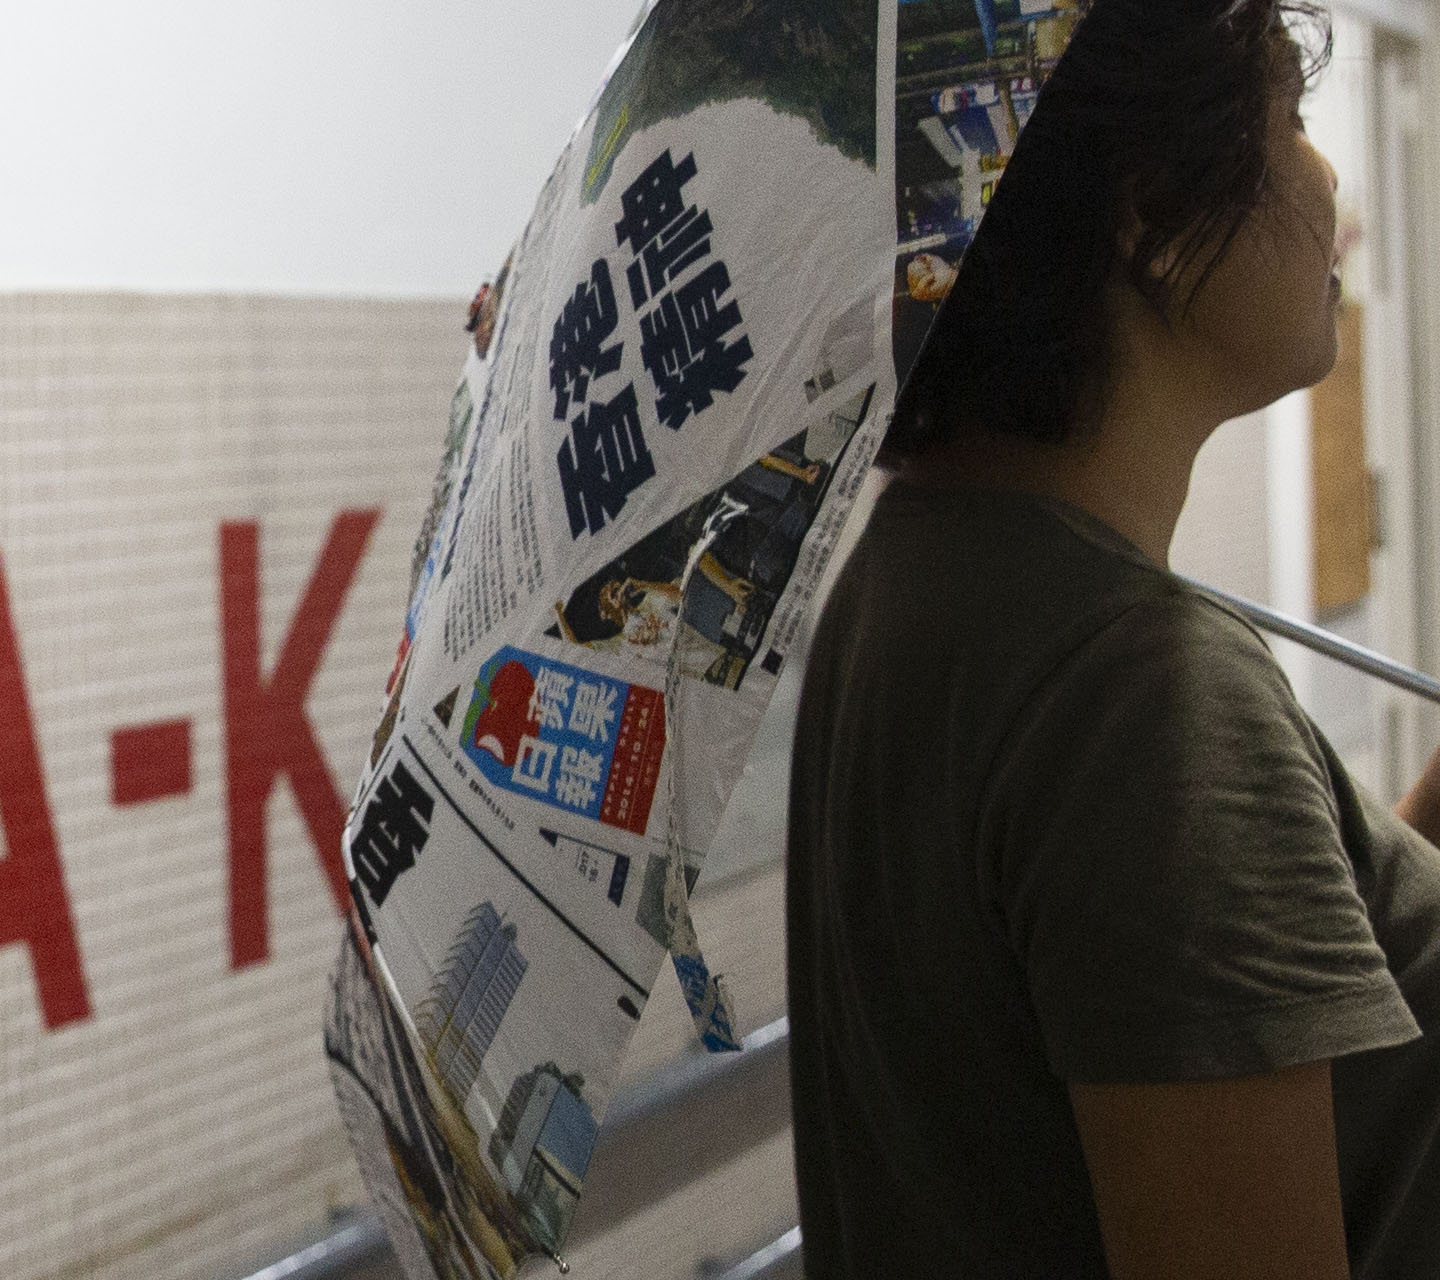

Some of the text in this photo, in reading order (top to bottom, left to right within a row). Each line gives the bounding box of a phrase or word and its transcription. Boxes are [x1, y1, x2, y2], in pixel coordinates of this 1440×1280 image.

[615, 148, 756, 432] 精神
[549, 257, 658, 542] 香港
[511, 733, 605, 810] 日報
[527, 666, 618, 743] 蘋果
